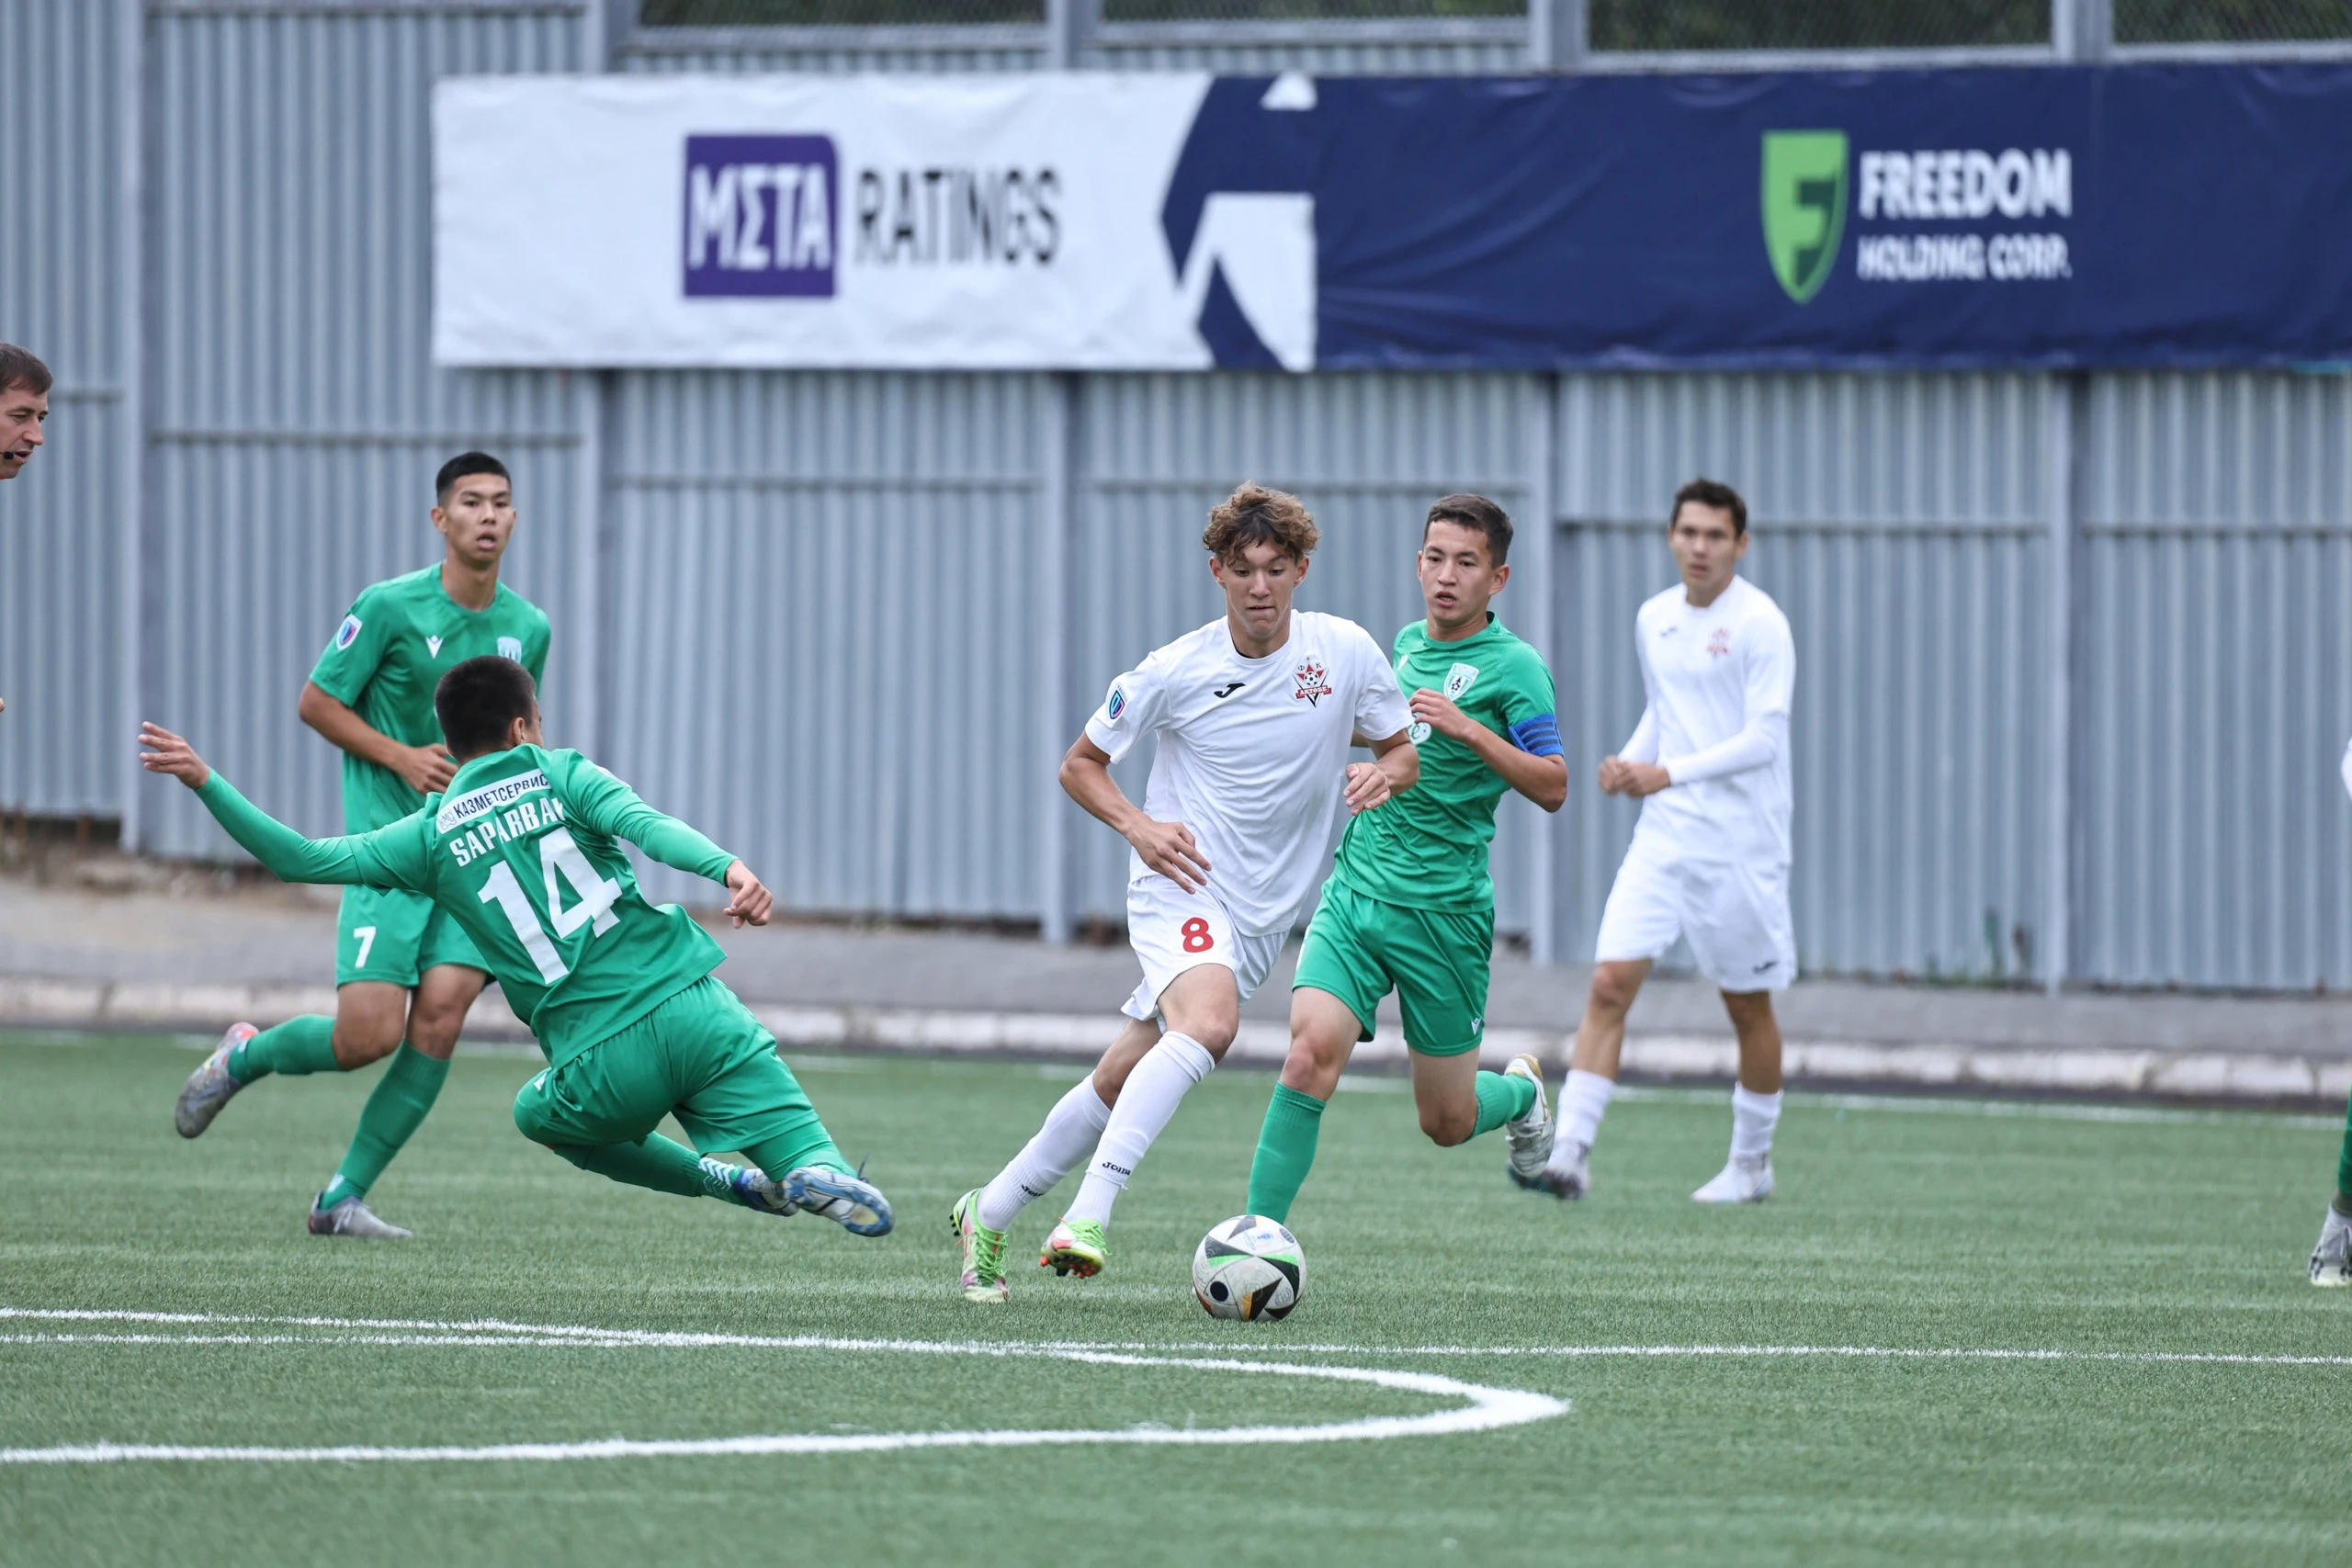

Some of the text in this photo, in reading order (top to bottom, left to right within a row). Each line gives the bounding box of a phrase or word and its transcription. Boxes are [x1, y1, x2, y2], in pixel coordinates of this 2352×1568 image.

[1858, 147, 2073, 220] FREEDOM
[854, 167, 1063, 265] RATINGS
[1856, 233, 2073, 281] HOLDING CORP.
[453, 773, 548, 819] КАЗМЕТСЕРВИС
[477, 826, 623, 985] 14
[353, 926, 377, 968] 7
[1181, 917, 1214, 953] 8
